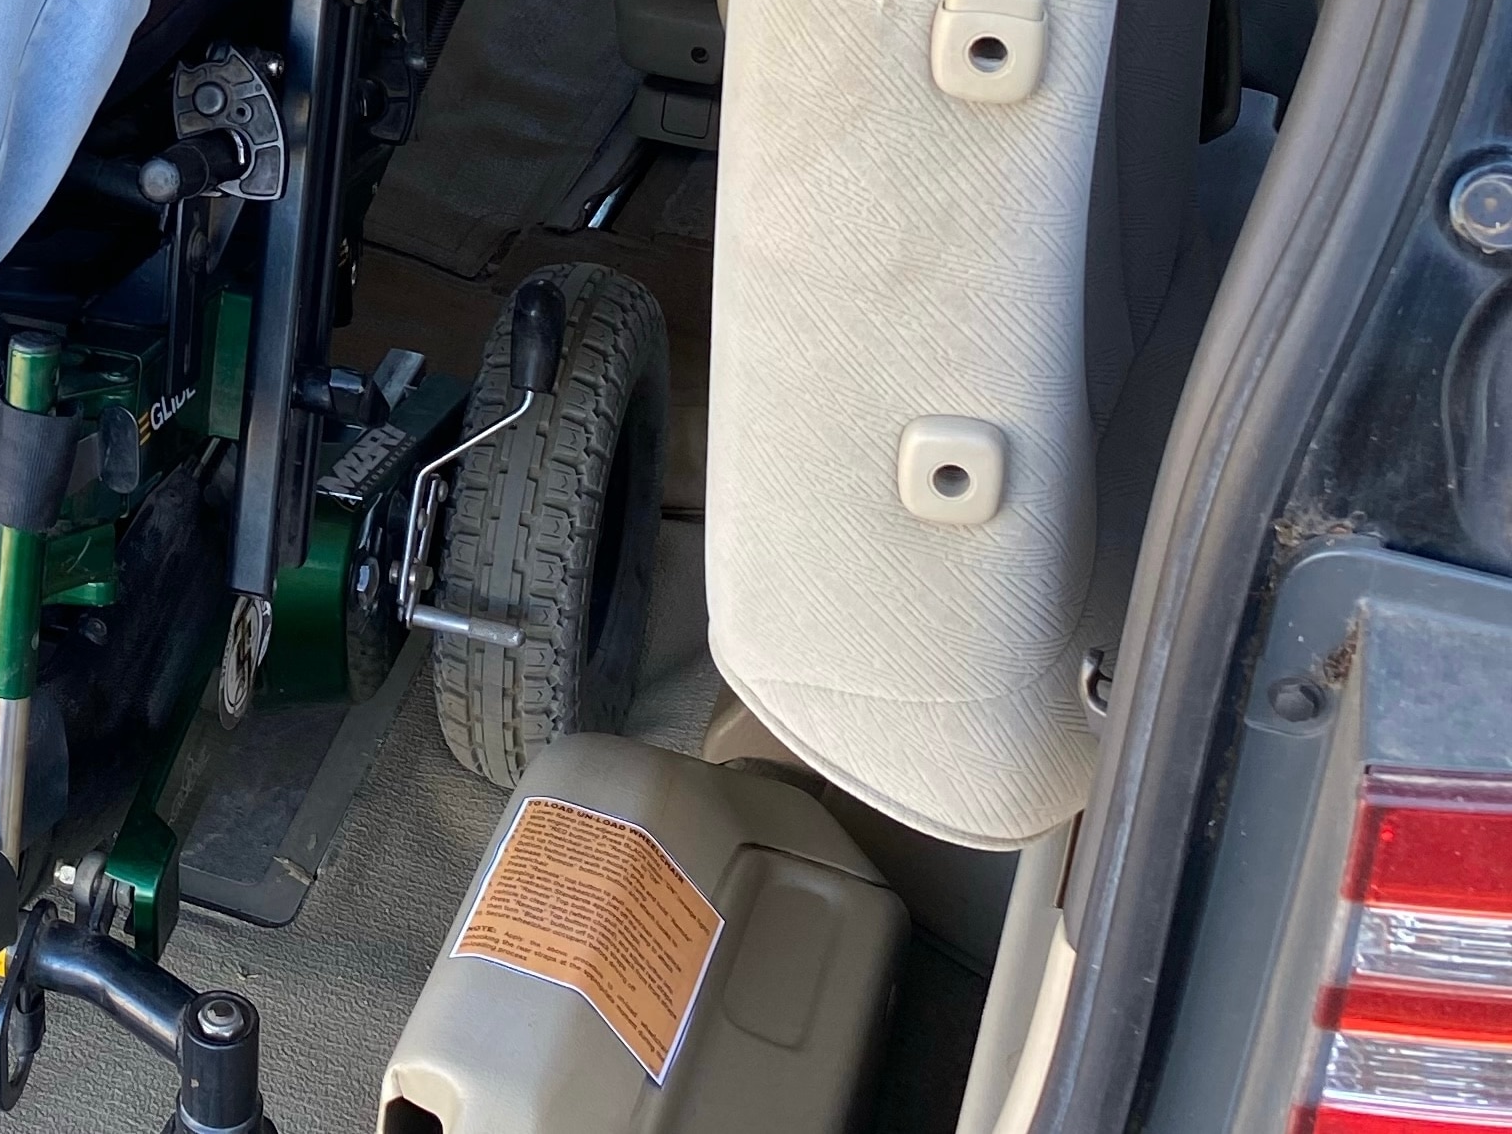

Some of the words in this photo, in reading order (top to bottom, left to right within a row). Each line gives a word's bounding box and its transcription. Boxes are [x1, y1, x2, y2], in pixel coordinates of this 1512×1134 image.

[543, 832, 581, 846] wheelchair
[544, 801, 573, 813] LOAD
[577, 811, 625, 830] UN-LOAD
[629, 828, 683, 883] WHEELCHAIR
[566, 847, 604, 861] wheelchair
